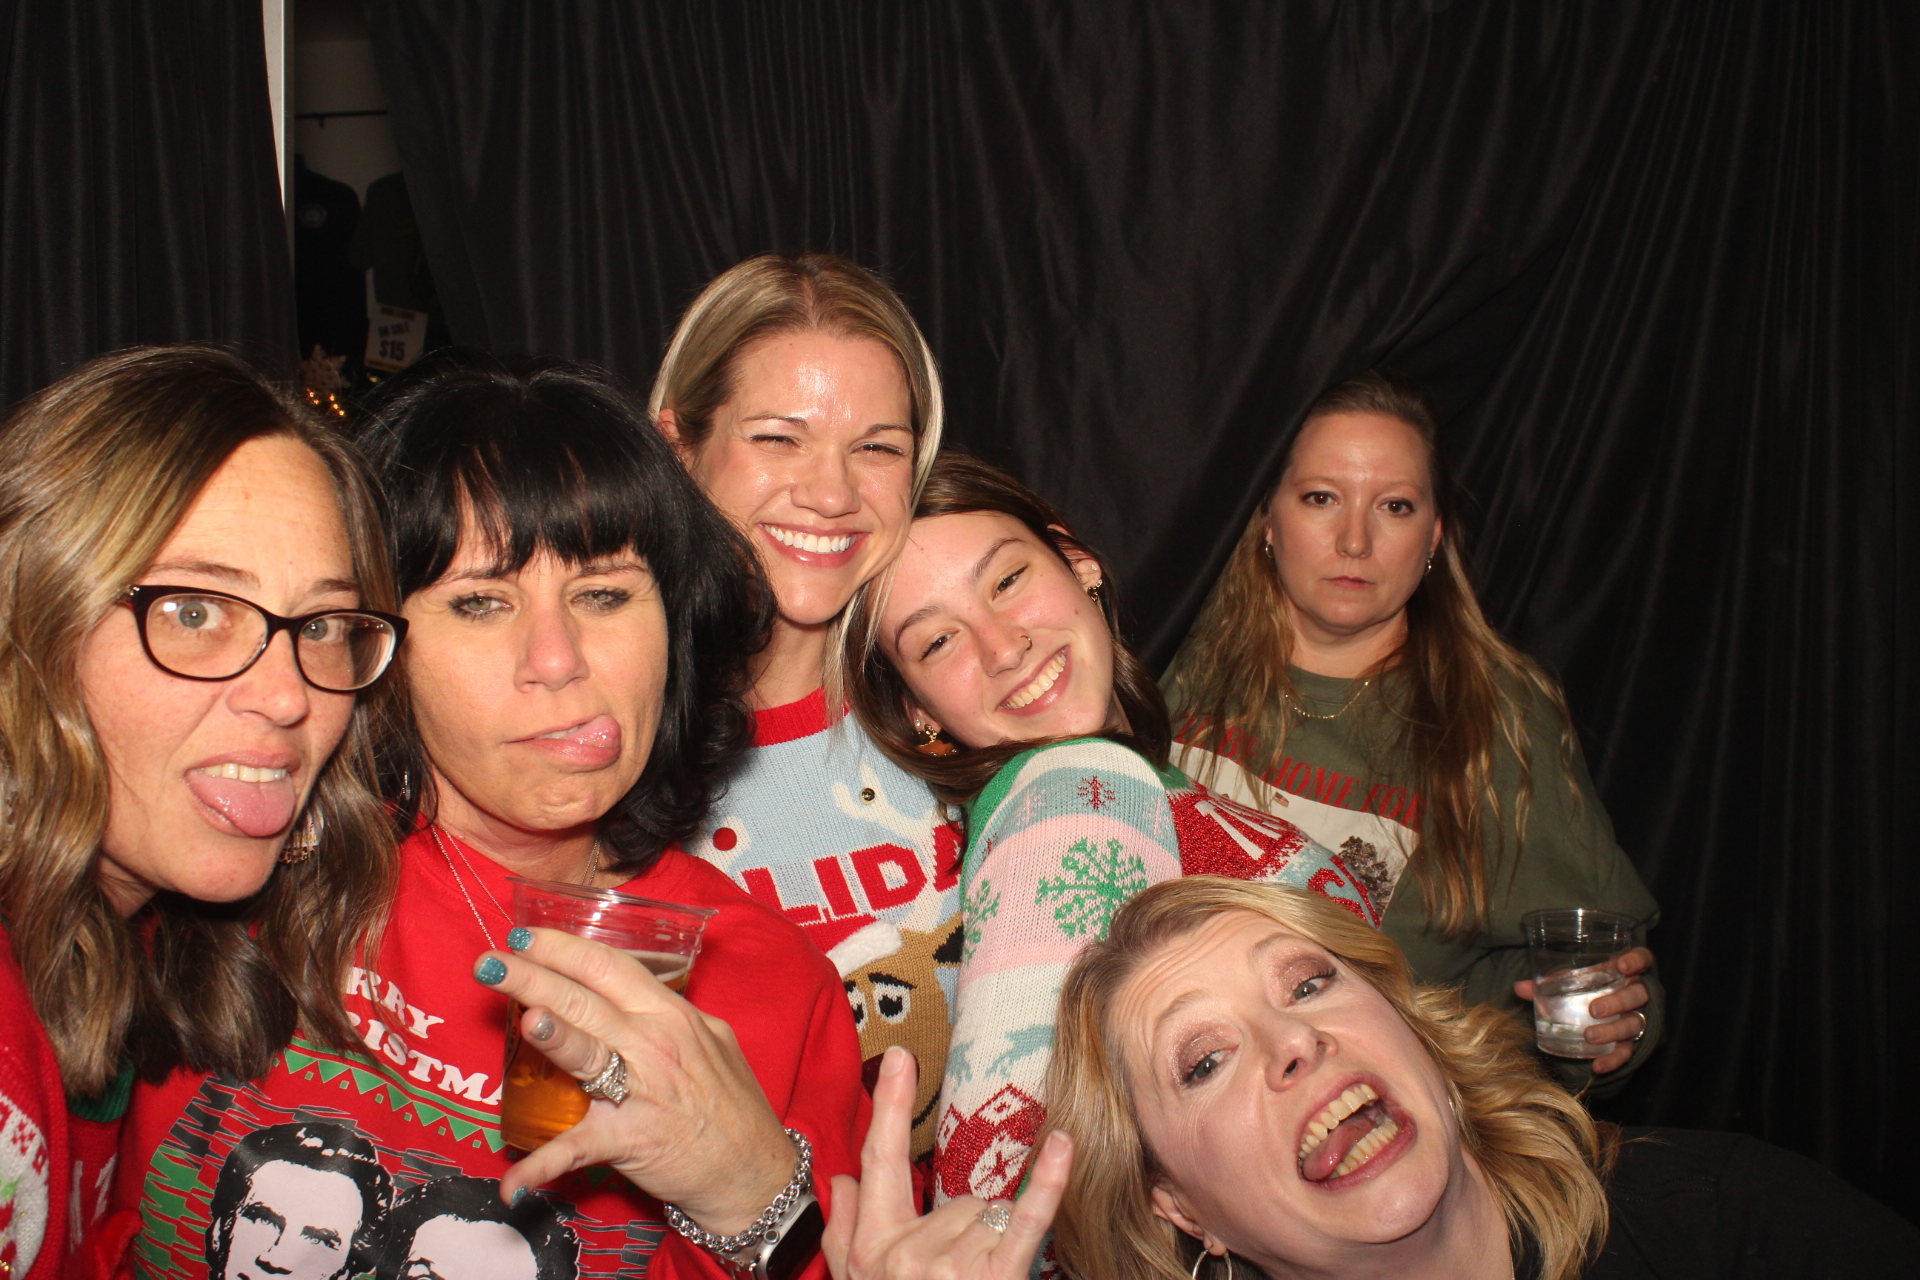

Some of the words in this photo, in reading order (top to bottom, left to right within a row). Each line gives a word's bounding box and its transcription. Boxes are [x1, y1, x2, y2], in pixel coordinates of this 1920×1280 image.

[378, 340, 405, 361] $15
[1260, 755, 1363, 810] HOME
[346, 966, 444, 1039] RRY
